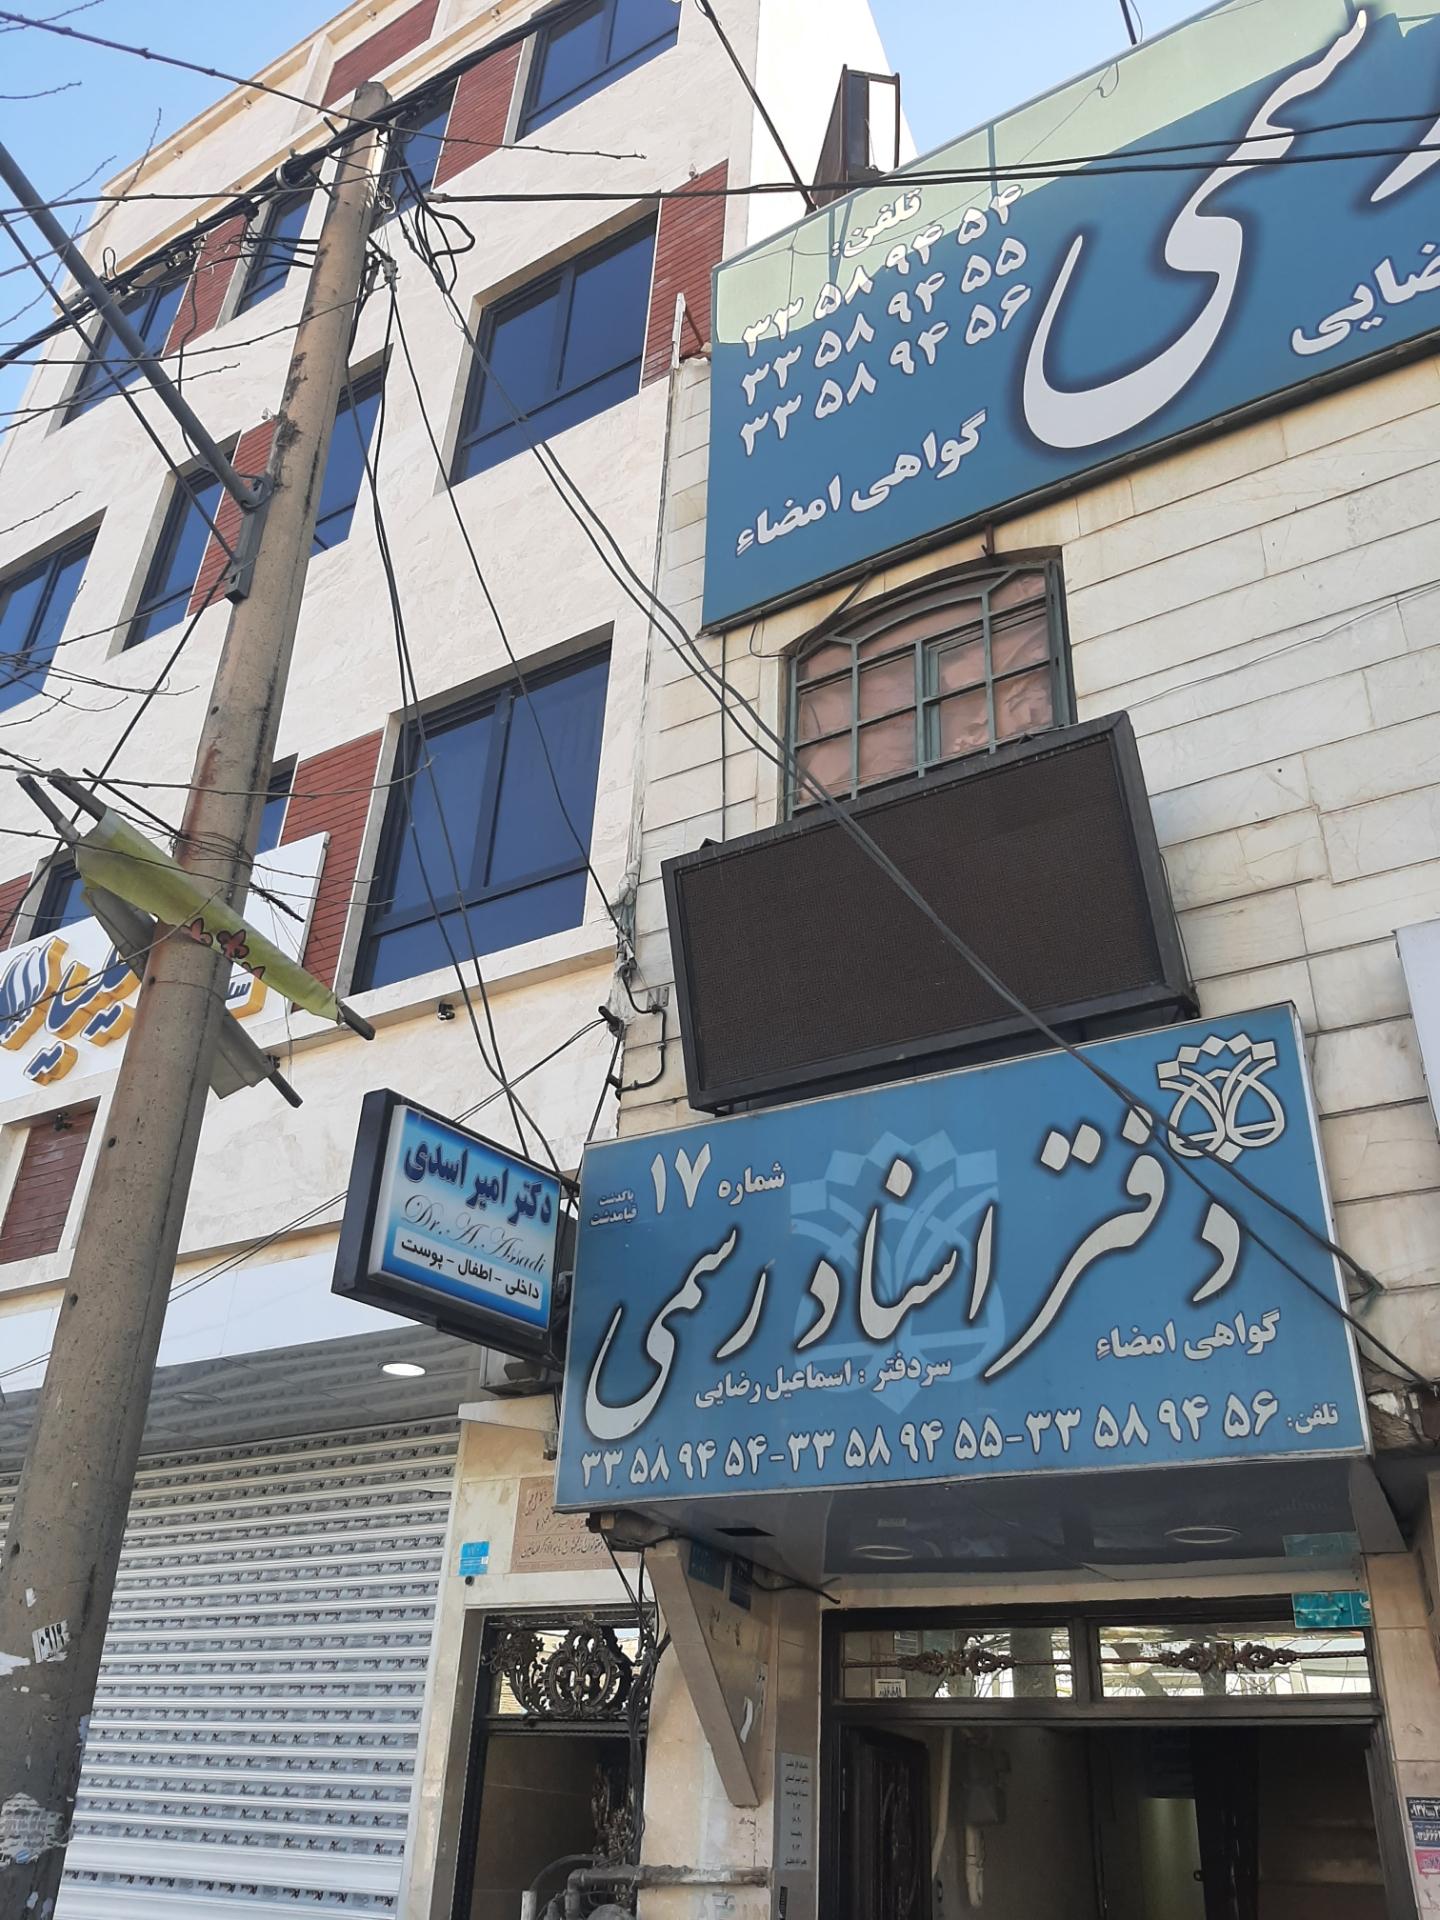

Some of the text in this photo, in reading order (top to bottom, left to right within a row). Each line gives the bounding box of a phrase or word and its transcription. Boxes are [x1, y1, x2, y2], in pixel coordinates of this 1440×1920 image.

[831, 188, 922, 258] تلفن:
[850, 408, 987, 512] گواهی
[403, 1140, 552, 1227] دکتر امیر اسدی
[650, 1142, 786, 1215] شماره ۱۷
[400, 1193, 444, 1236] Dr.
[482, 1226, 547, 1277] Assadi
[400, 1237, 444, 1270] پوست
[457, 1258, 494, 1284] اطفال
[504, 1276, 540, 1301] داخلی
[585, 1105, 1242, 1441] دفتر اسناد رسمی
[1182, 1307, 1281, 1361] گواهی
[695, 1371, 761, 1408] رضایی
[766, 1359, 851, 1402] اسماعیل
[1286, 1401, 1339, 1435] تلفن:
